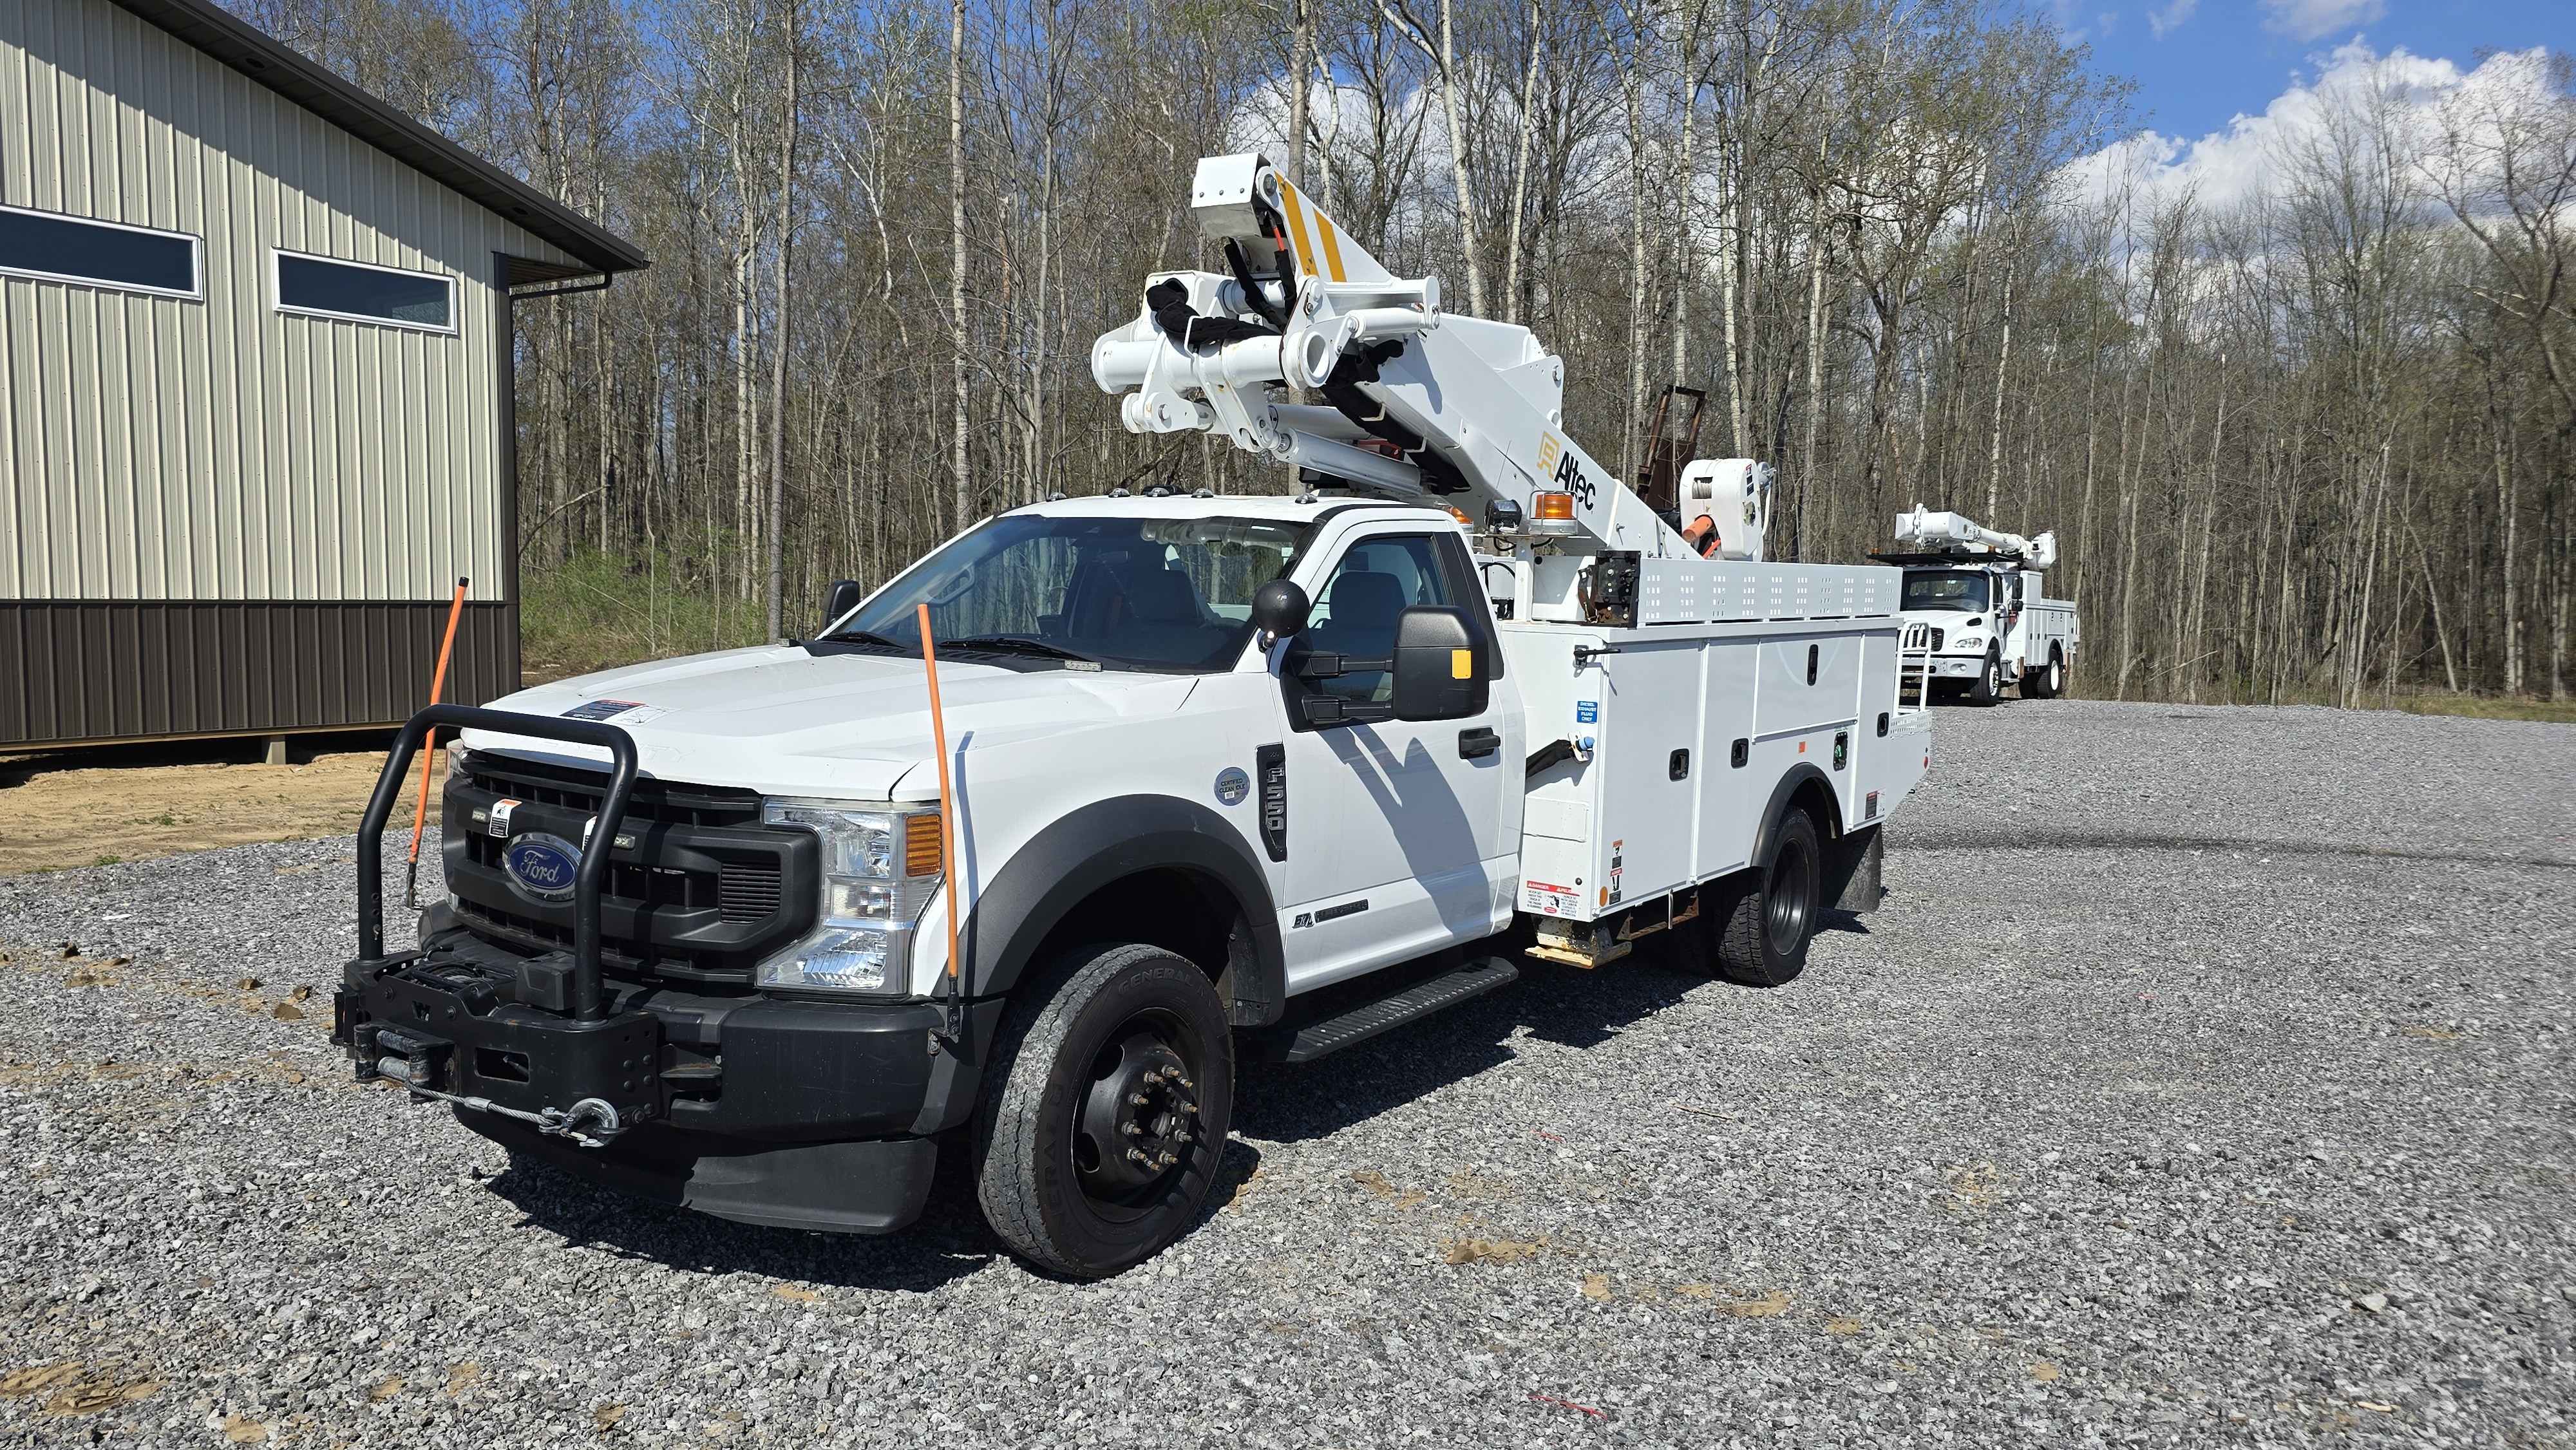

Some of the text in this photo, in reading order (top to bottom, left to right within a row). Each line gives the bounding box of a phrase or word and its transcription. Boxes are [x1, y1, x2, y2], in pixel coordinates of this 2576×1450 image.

[1554, 451, 1596, 511] Altec
[1220, 778, 1243, 787] CERTIFIED
[519, 850, 561, 883] Ford
[1118, 967, 1194, 995] GENERAL
